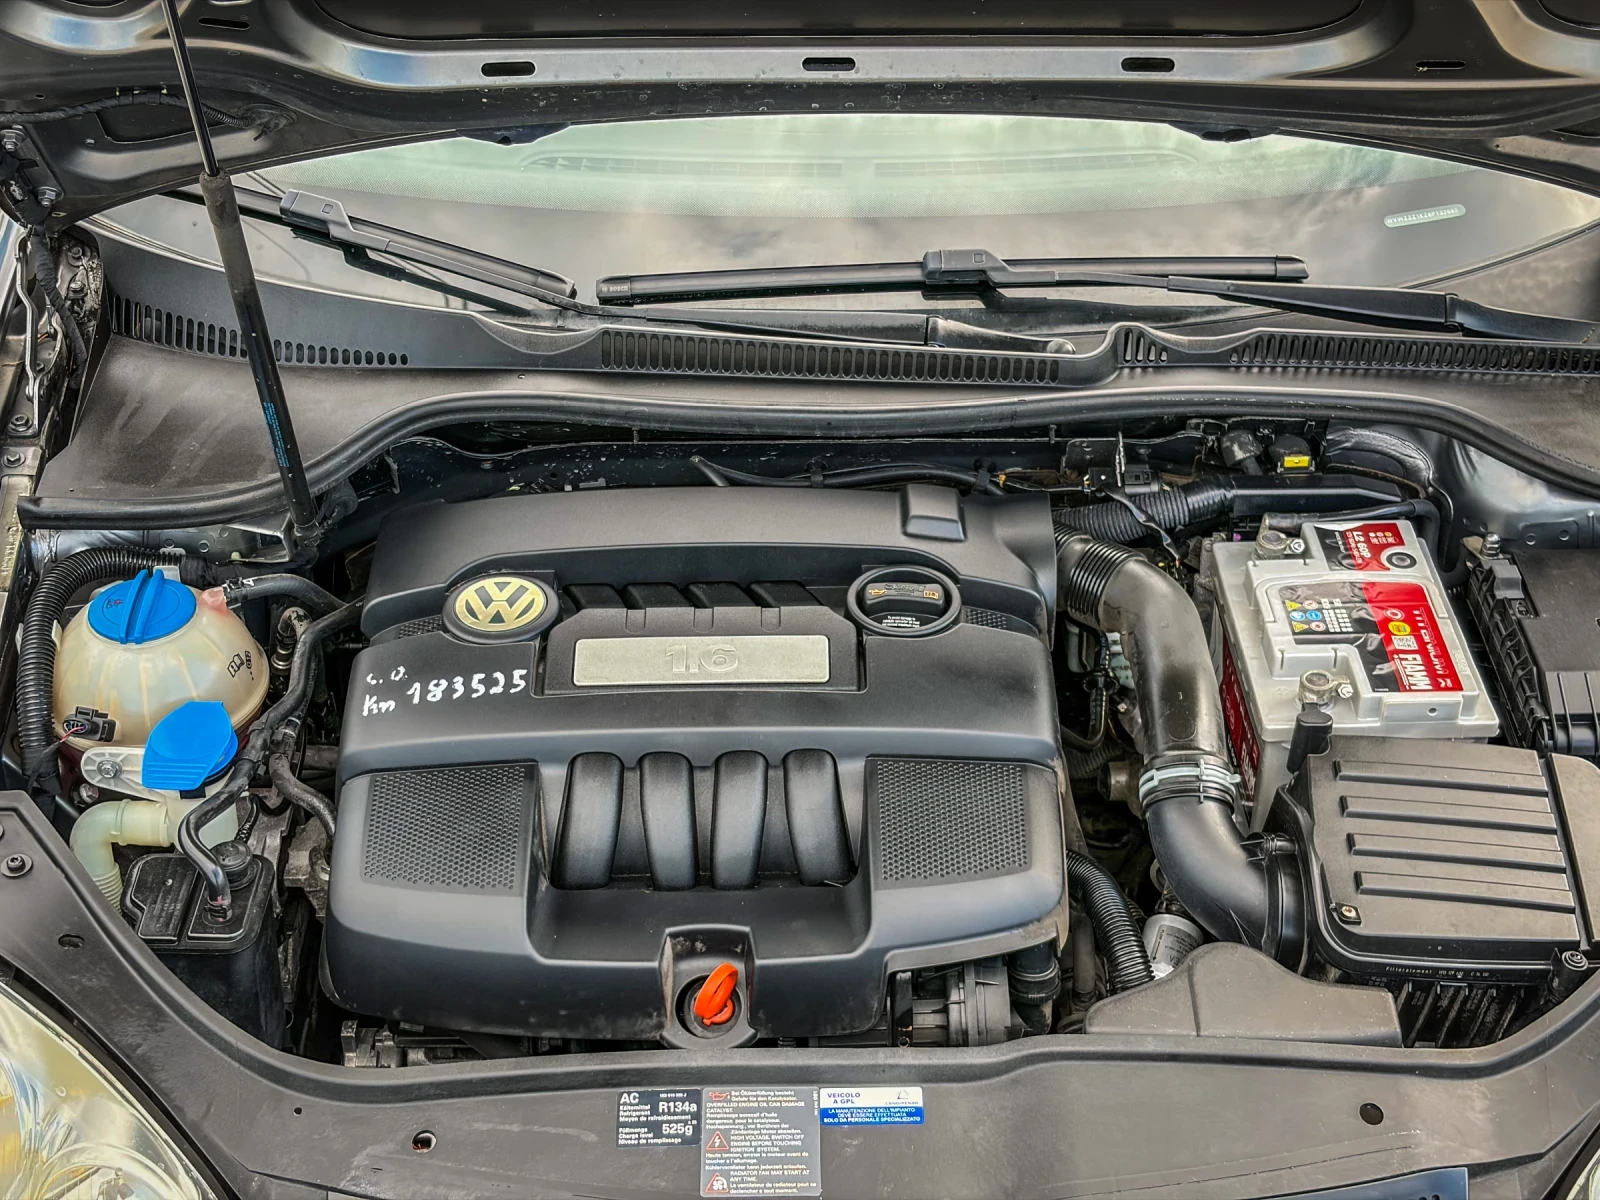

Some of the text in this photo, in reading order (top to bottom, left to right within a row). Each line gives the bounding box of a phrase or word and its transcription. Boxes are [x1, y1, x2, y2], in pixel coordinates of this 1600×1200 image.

[1352, 531, 1371, 558] L2 60P
[665, 645, 738, 674] 1.6
[1398, 654, 1433, 690] FIAMM
[406, 669, 528, 705] 183525
[620, 1093, 640, 1104] AC
[659, 1101, 698, 1112] R134a
[662, 1123, 694, 1136] 525g
